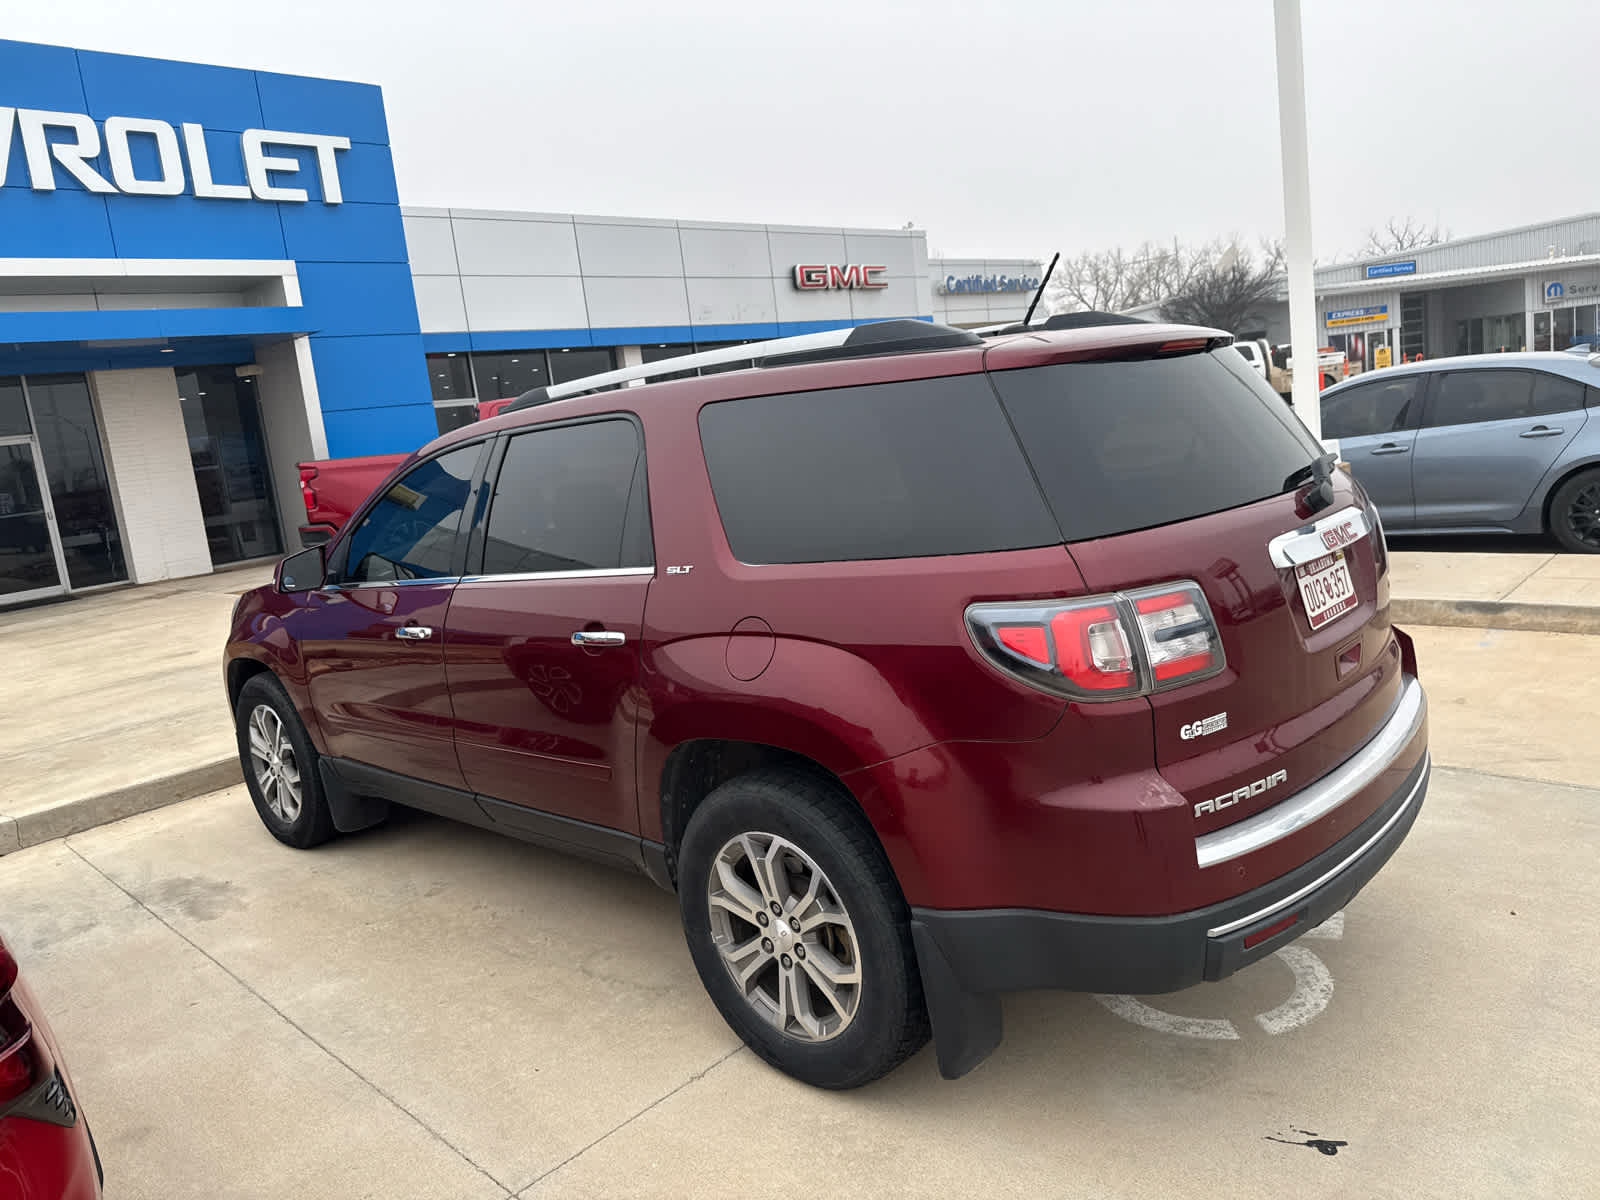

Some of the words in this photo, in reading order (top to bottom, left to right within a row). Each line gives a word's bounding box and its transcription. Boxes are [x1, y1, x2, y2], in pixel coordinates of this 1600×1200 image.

[795, 264, 888, 289] GMC
[946, 274, 997, 293] Certified
[999, 274, 1040, 292] Service
[1320, 521, 1358, 547] GMC
[666, 565, 694, 574] SLT
[1193, 769, 1288, 818] ACADIA
